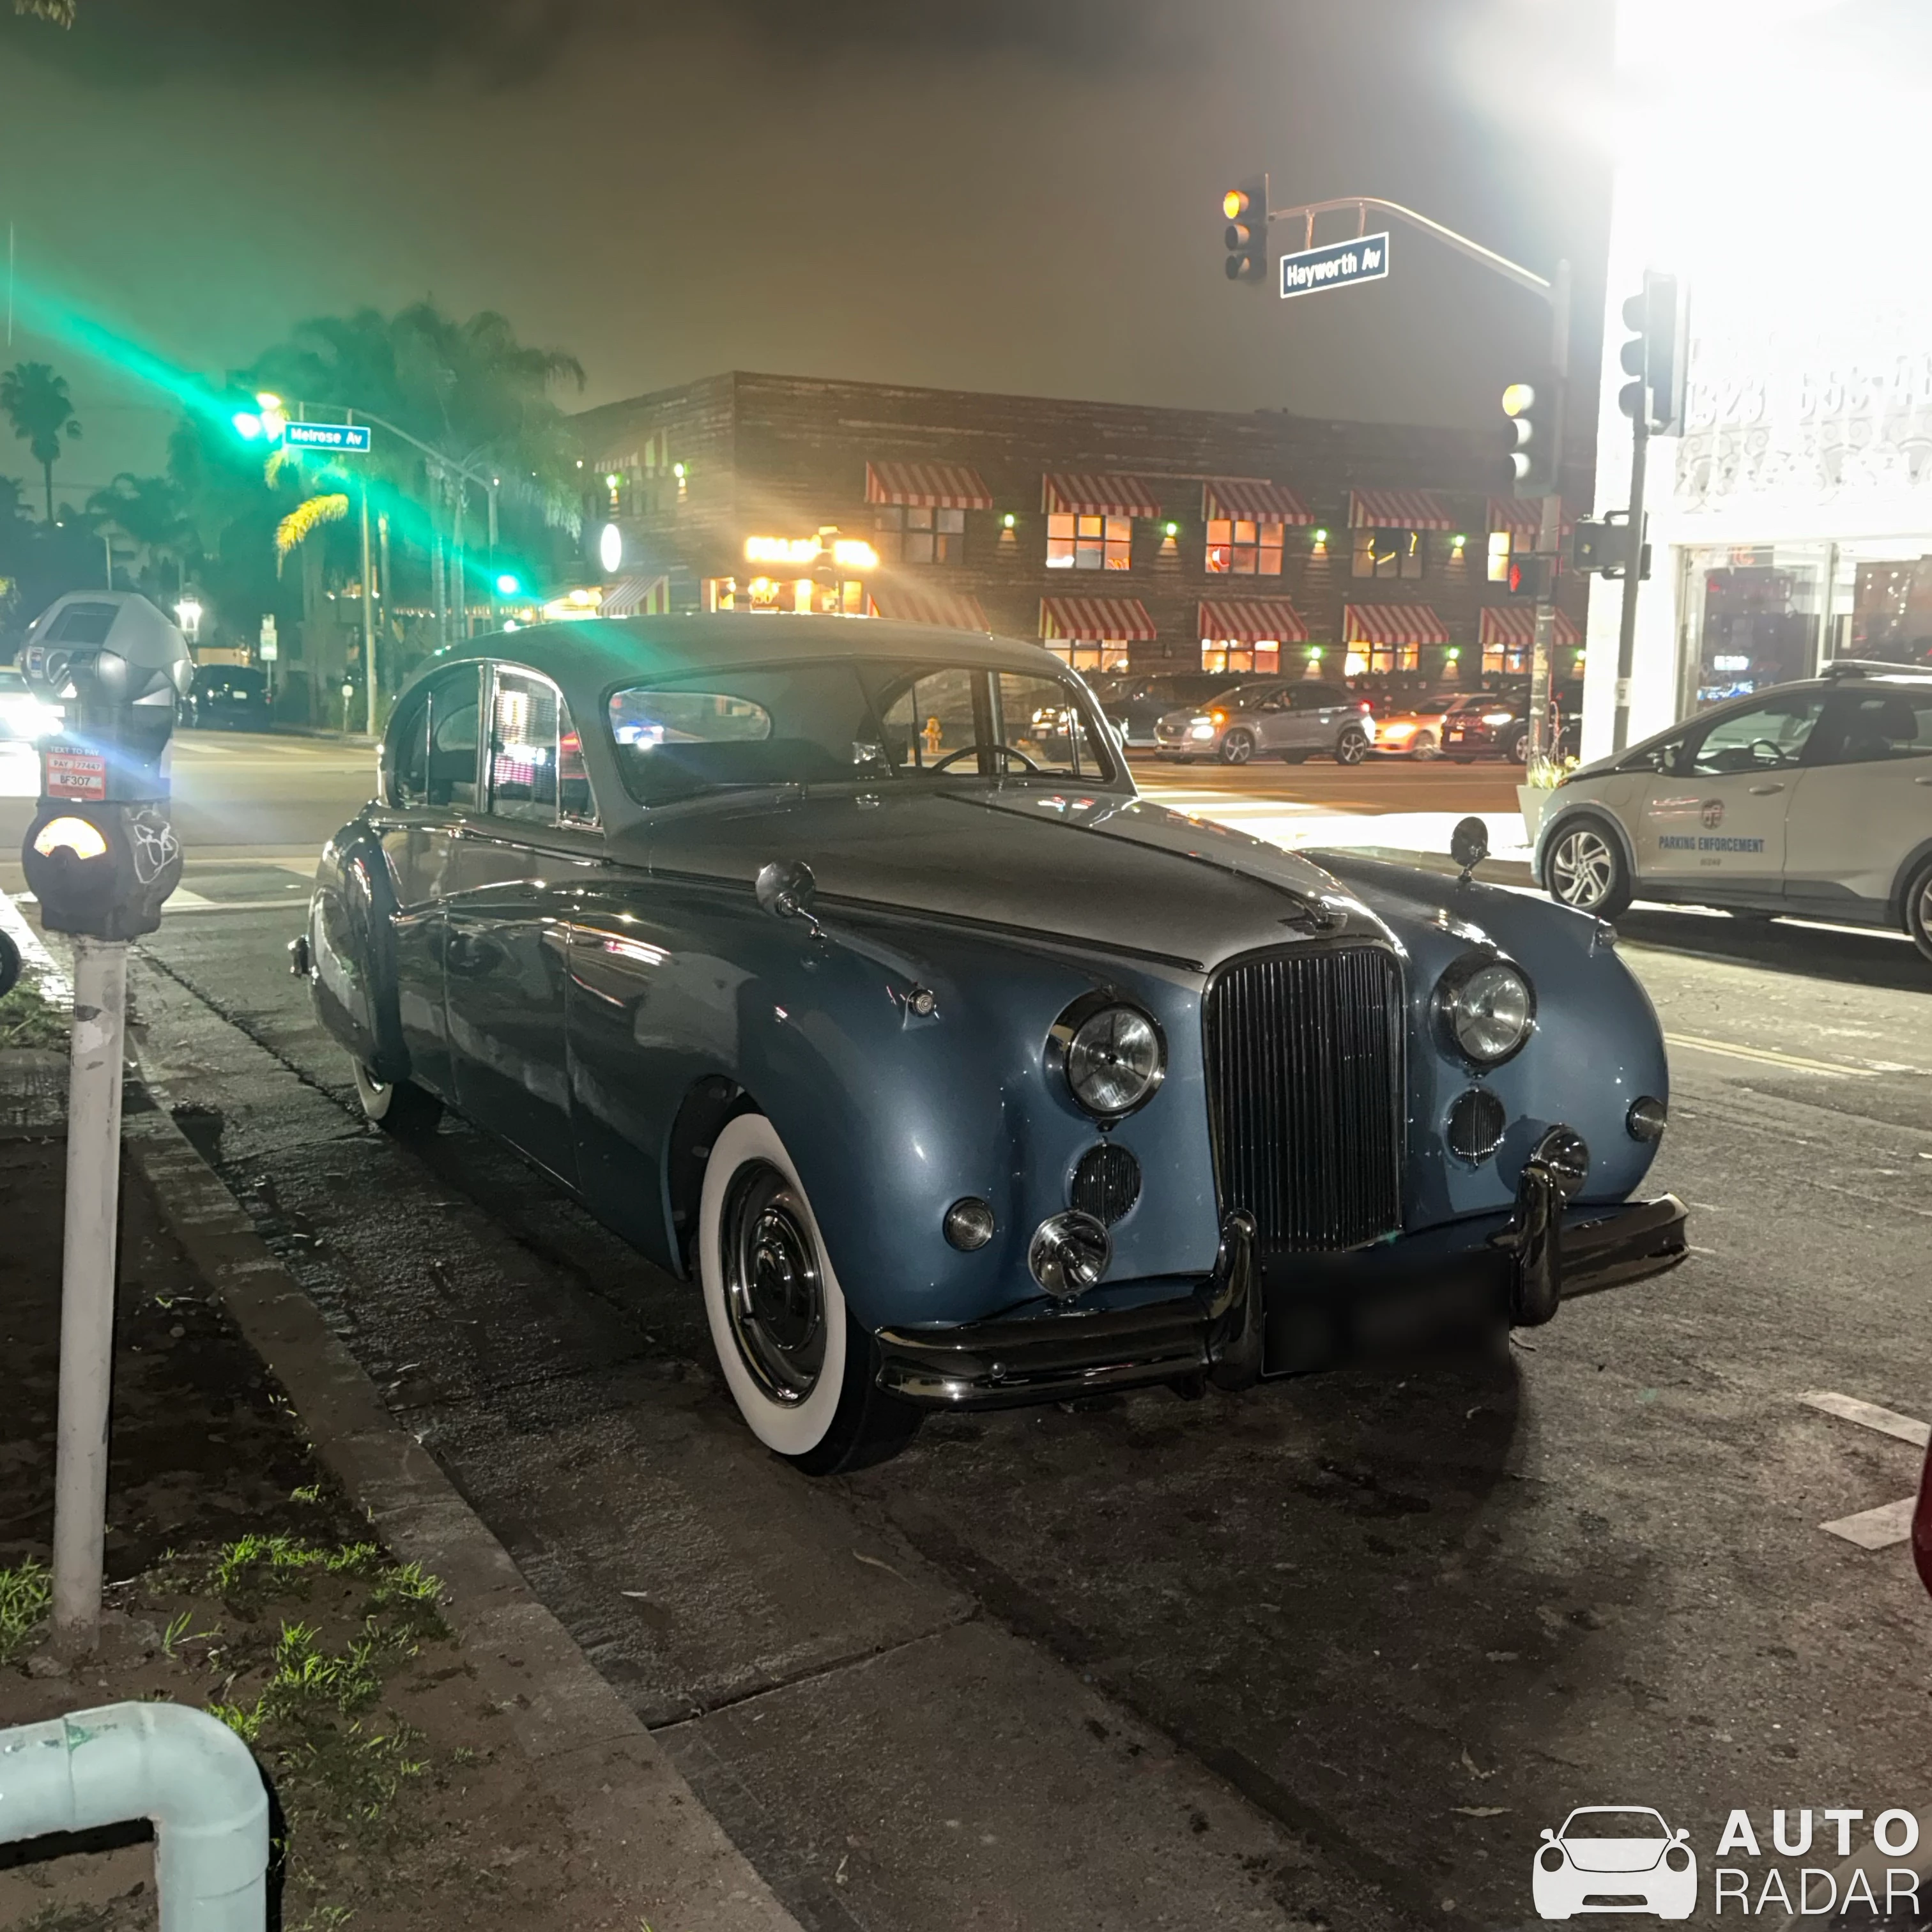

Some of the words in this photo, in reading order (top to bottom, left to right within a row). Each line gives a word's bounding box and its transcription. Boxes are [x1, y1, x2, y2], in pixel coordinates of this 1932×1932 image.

[1287, 252, 1357, 288] Hayworth
[1361, 247, 1381, 271] Av
[291, 427, 341, 444] Melrose
[346, 431, 362, 445] Av
[60, 775, 90, 786] BF307
[1659, 836, 1696, 850] PARKING
[1698, 837, 1765, 852] ENFORCEMENT
